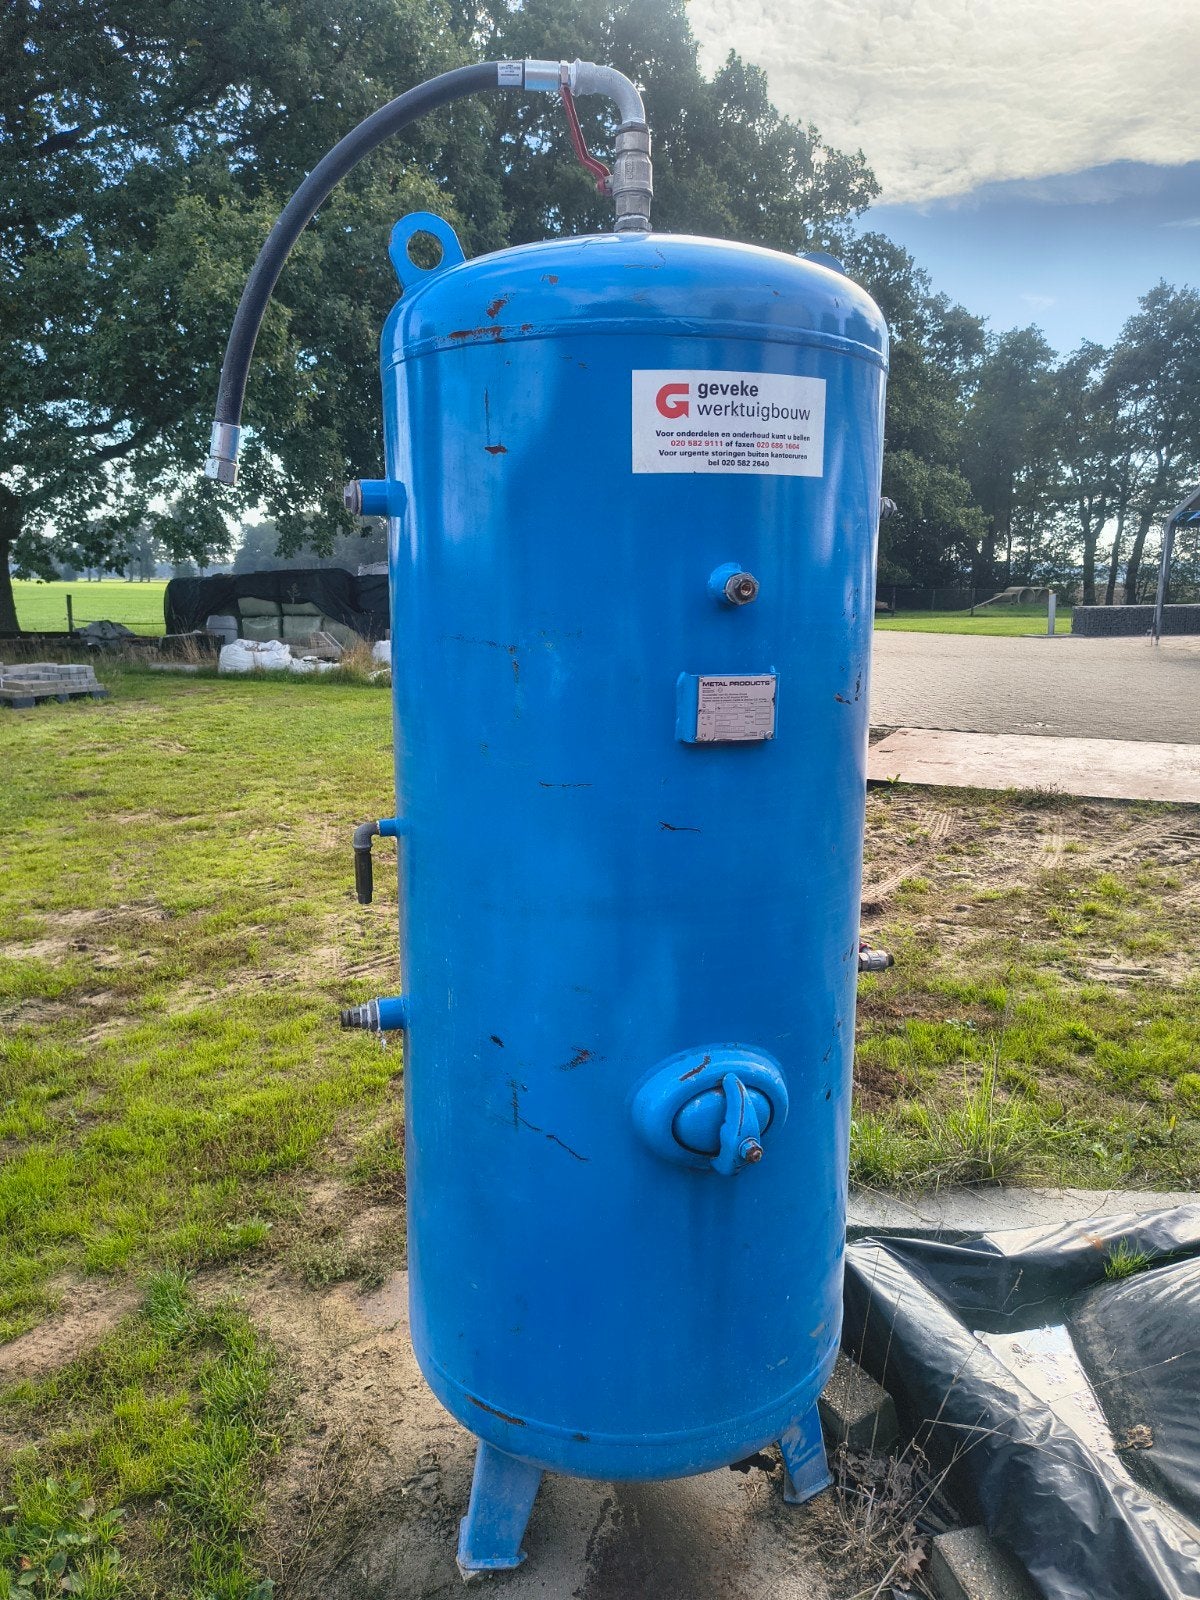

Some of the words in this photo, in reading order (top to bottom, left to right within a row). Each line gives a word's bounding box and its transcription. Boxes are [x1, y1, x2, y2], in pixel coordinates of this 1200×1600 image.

[697, 380, 759, 398] geveke
[697, 401, 811, 421] werktuigbouw
[732, 431, 770, 439] onderhoud
[792, 433, 811, 441] bellen
[770, 452, 808, 460] kantooruren
[737, 459, 751, 467] 582
